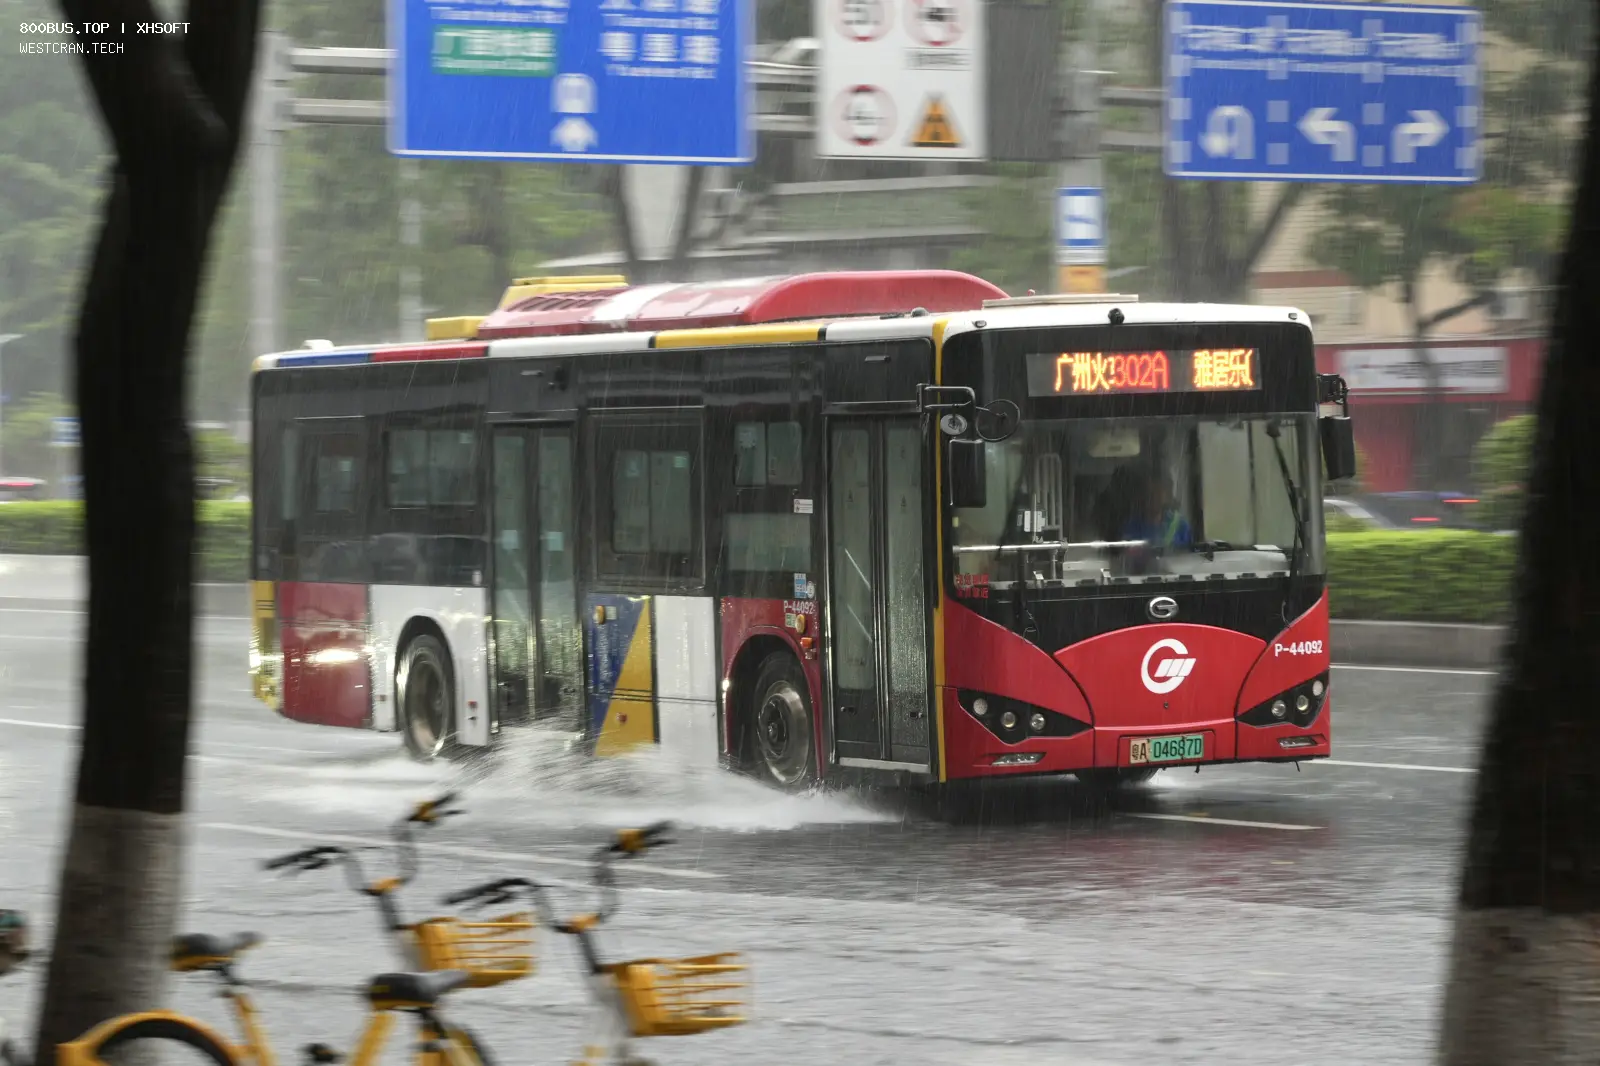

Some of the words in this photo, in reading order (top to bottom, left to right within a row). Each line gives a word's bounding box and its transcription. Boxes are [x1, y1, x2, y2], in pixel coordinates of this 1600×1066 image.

[1114, 351, 1168, 389] 302A
[783, 600, 814, 614] P-44092
[1274, 640, 1323, 657] P-44092
